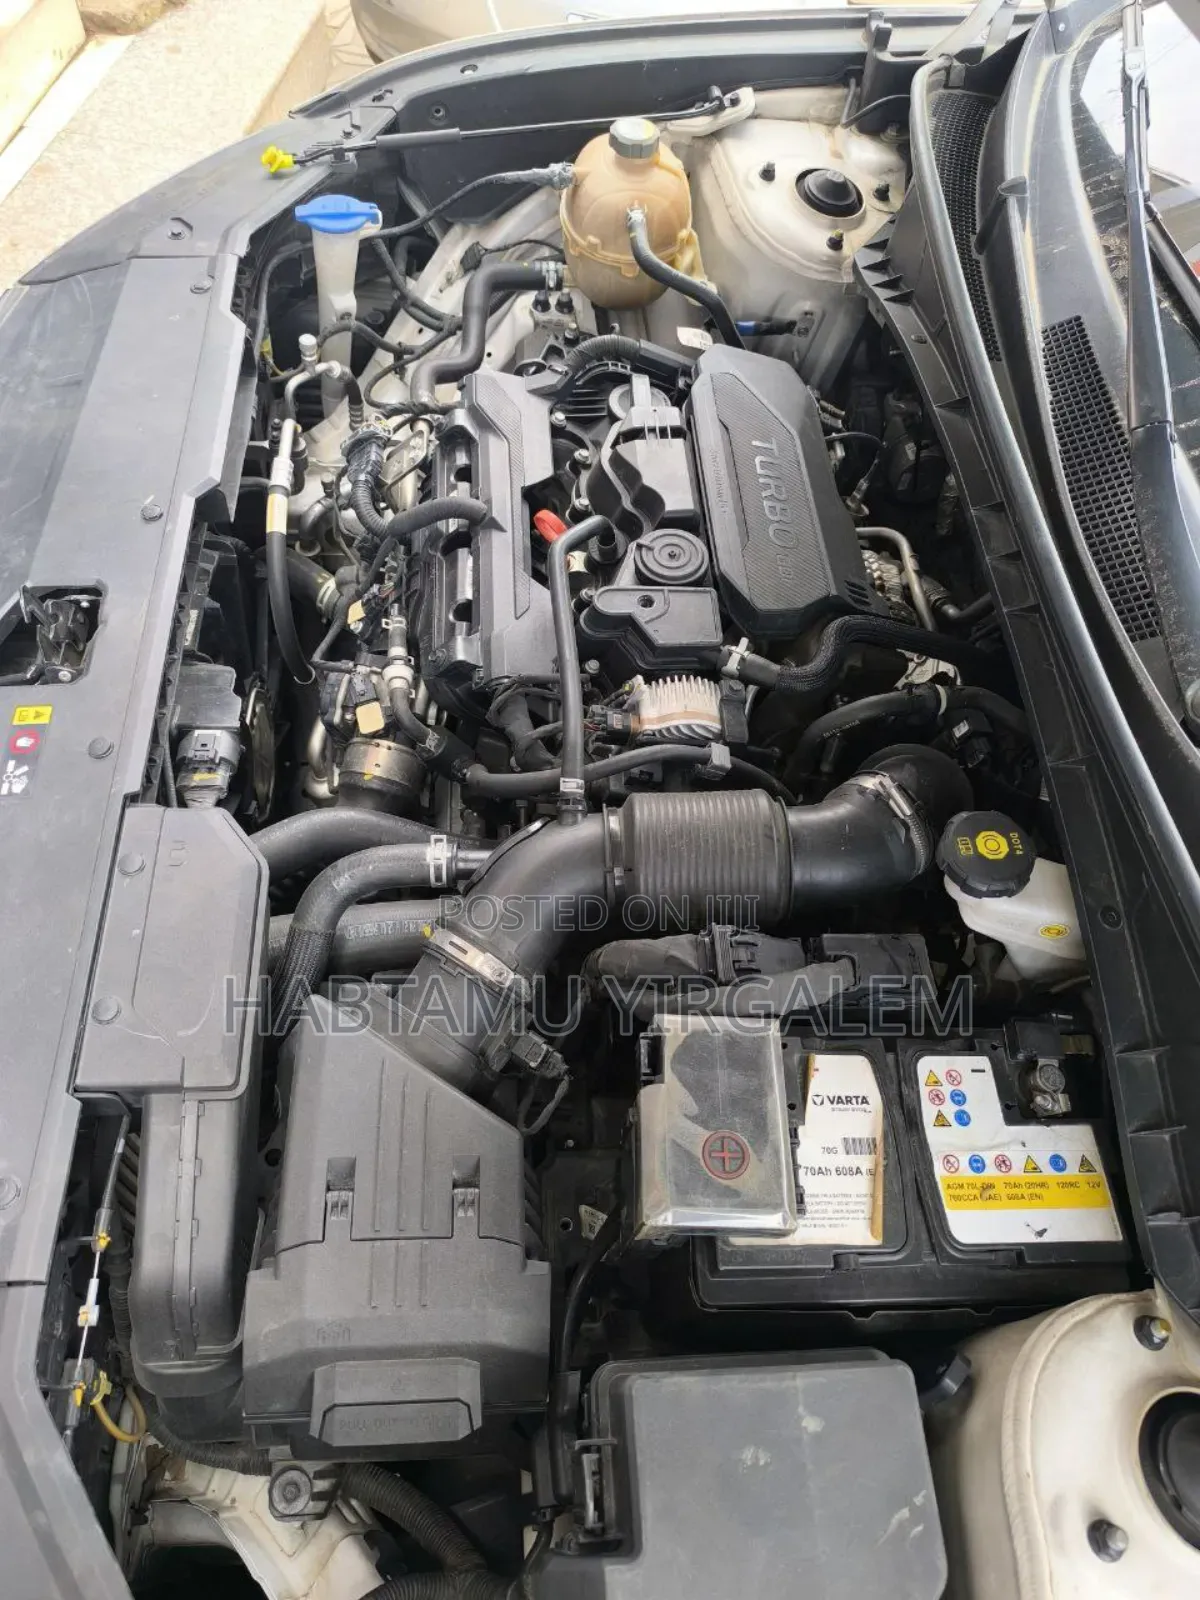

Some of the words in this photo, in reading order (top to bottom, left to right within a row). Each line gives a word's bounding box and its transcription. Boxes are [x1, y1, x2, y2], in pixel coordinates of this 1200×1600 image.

[751, 437, 799, 550] TURBO
[826, 1095, 870, 1106] VARTA
[821, 1146, 838, 1155] 70G
[803, 1166, 832, 1177] 70Ah
[835, 1166, 863, 1177] 608A
